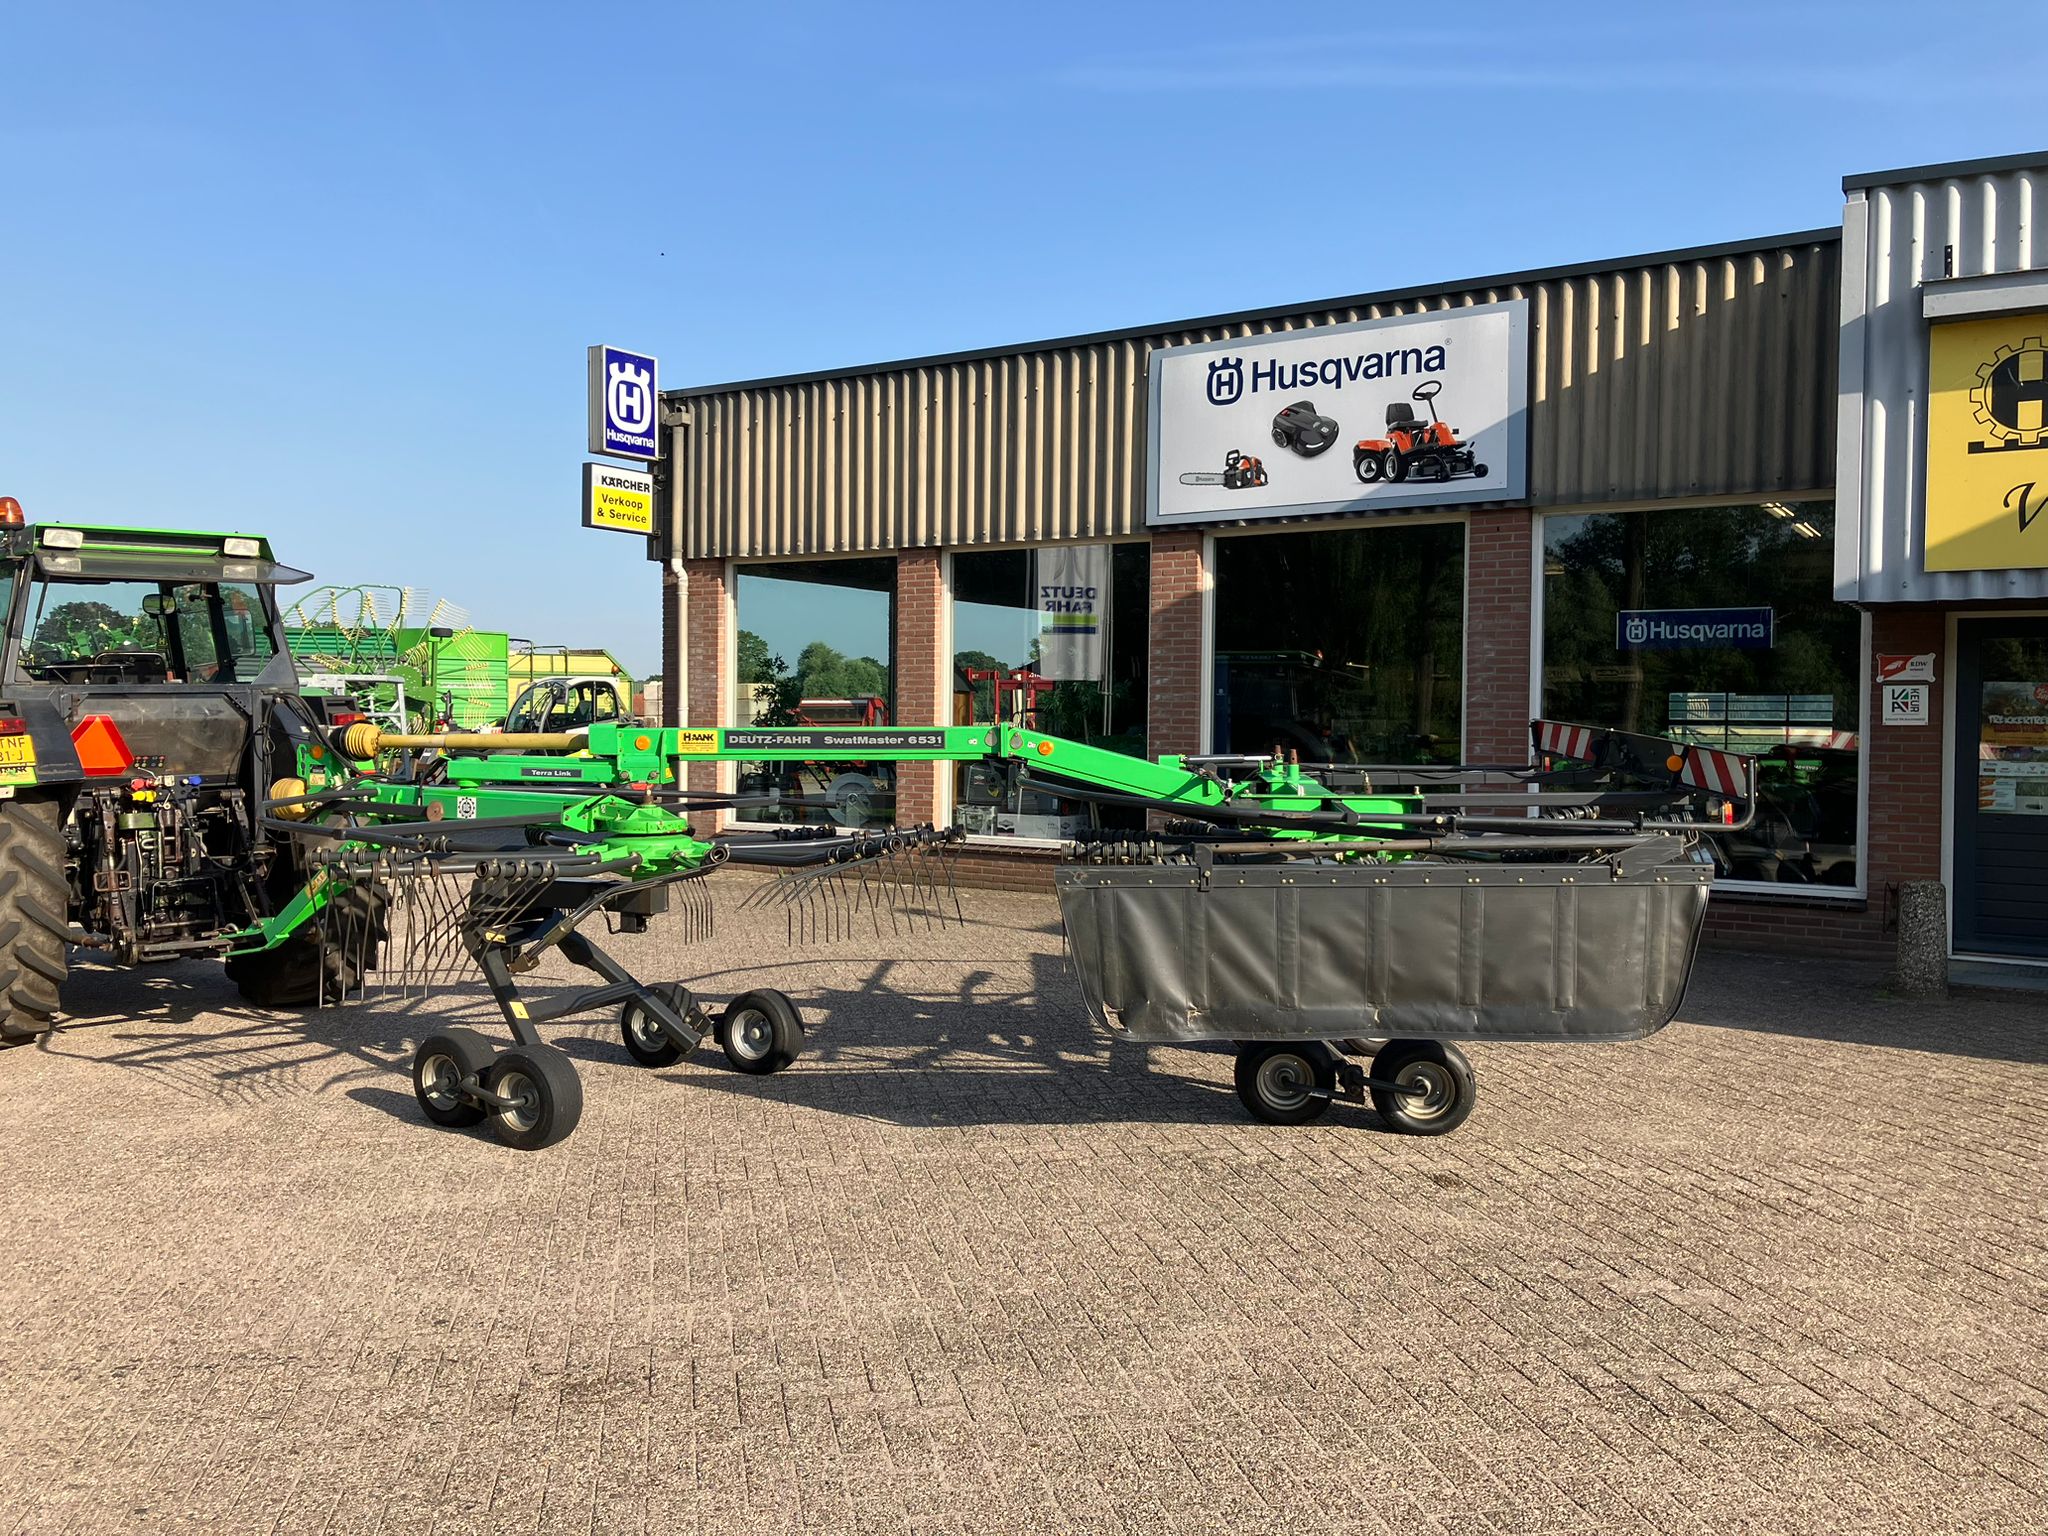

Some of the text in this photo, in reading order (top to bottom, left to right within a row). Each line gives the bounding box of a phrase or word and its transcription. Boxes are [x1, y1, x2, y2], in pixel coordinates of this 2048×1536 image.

[1251, 345, 1446, 393] Husqvarna
[606, 429, 654, 448] Husqvarna
[601, 475, 651, 493] KÄRCHER
[601, 493, 643, 510] Verkoop
[597, 508, 647, 524] & Service
[1650, 621, 1765, 642] Husqvarna
[1910, 688, 1920, 713] KEUR
[728, 735, 942, 745] DEUTZ-FAHR SwatMaster 6531
[554, 769, 572, 777] Link
